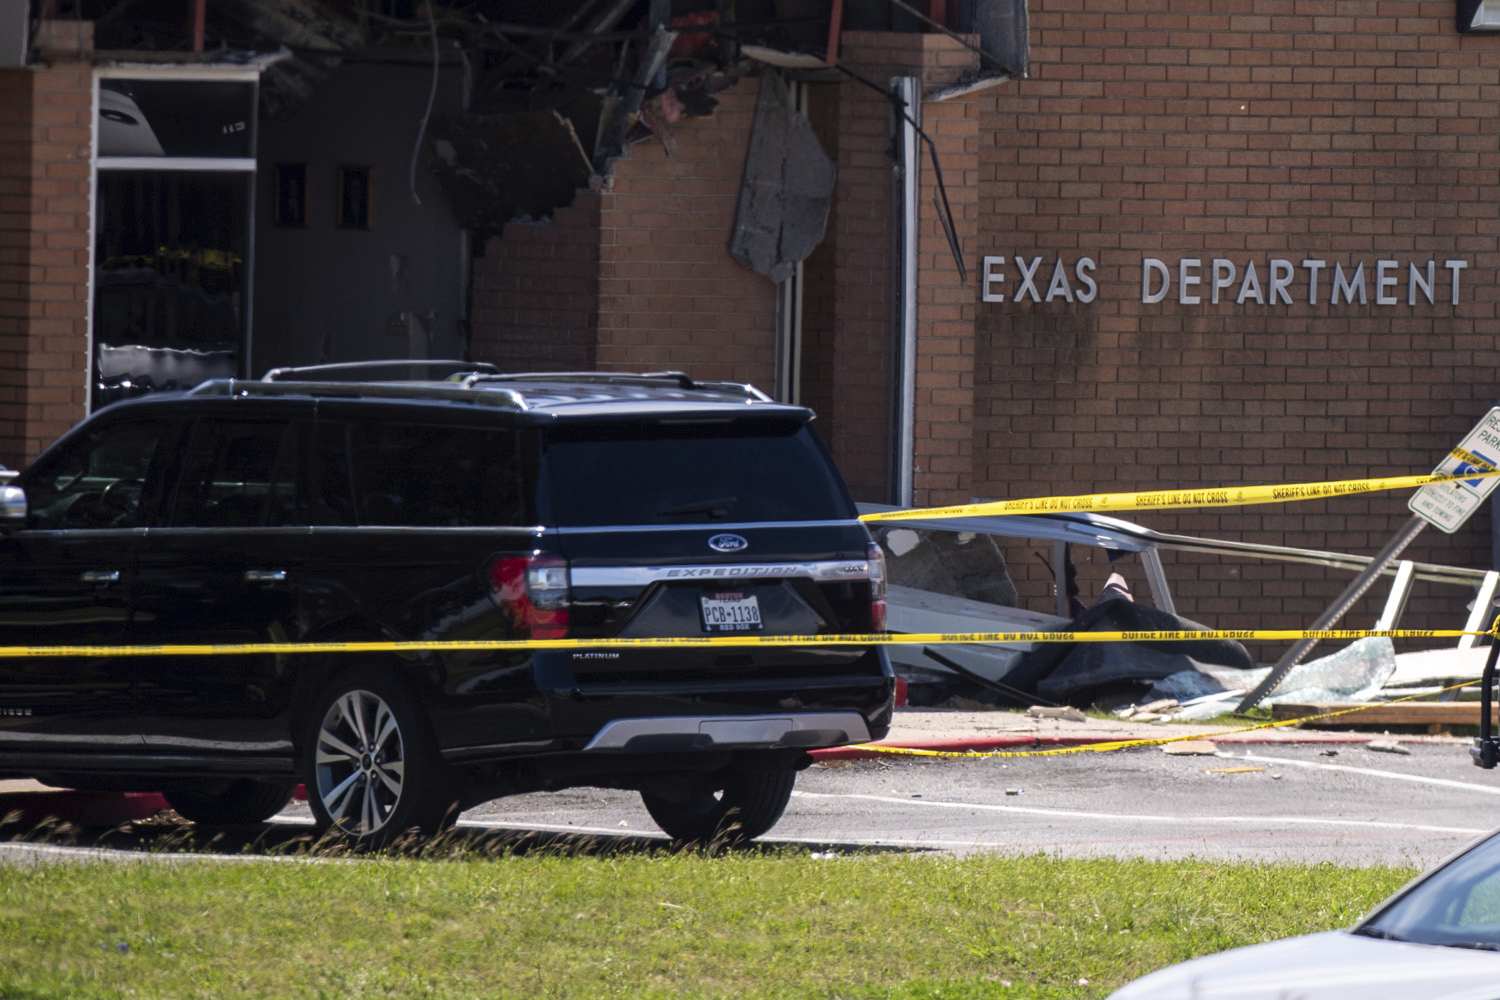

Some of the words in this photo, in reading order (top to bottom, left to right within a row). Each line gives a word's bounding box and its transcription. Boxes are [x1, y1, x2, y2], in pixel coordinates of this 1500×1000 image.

[982, 255, 1098, 304] EXAS
[1142, 257, 1468, 307] DEPARTMENT
[1135, 493, 1166, 506] SHERIFF'S
[1167, 493, 1181, 505] LINE
[1182, 492, 1191, 504] DO
[1193, 492, 1205, 504] NOT
[1206, 491, 1228, 504] CROSS
[718, 536, 740, 549] Ford
[667, 567, 798, 578] EXPEDITION
